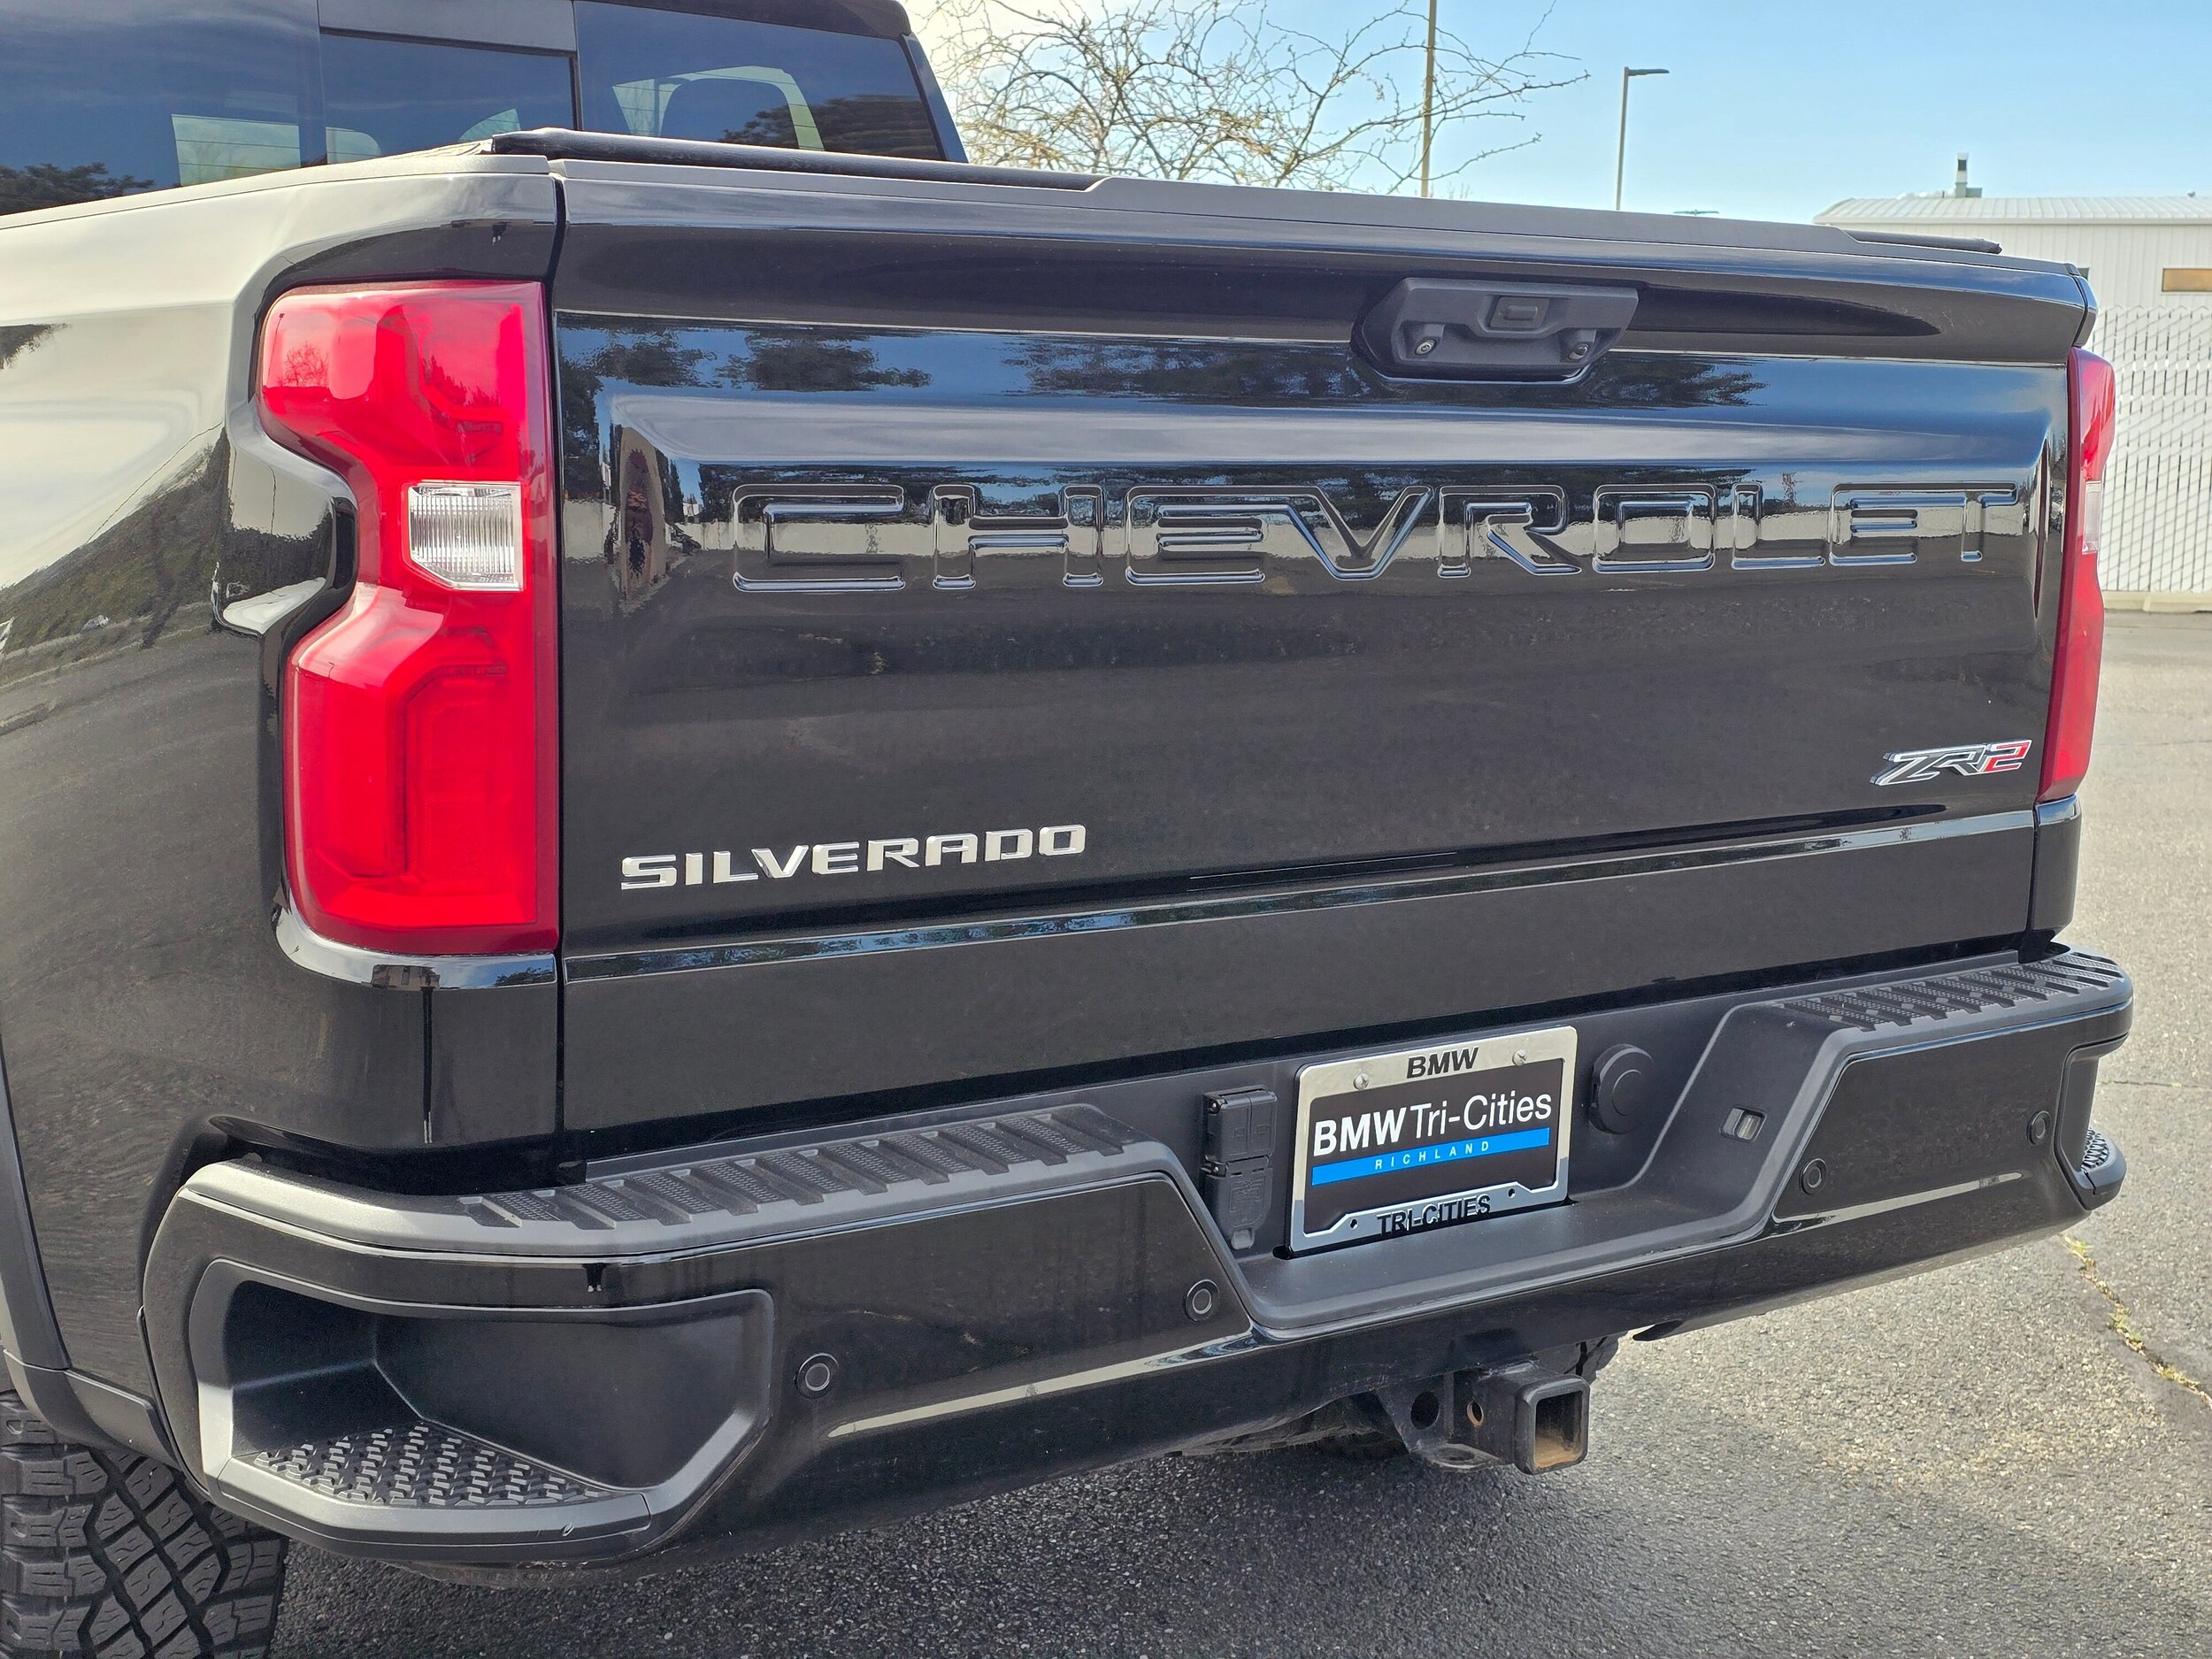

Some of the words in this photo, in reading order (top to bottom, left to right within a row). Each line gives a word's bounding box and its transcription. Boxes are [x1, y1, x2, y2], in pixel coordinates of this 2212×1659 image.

[733, 482, 2017, 592] CHEVROLET
[1870, 740, 2032, 786] ZR2
[620, 824, 1086, 890] SILVERADO
[1406, 1047, 1479, 1079] BMW
[1313, 1107, 1406, 1156] BMW
[1409, 1090, 1552, 1139] Tri-Cities
[1374, 1141, 1489, 1171] RICHLAND
[1376, 1194, 1491, 1236] TRI-CITIES
